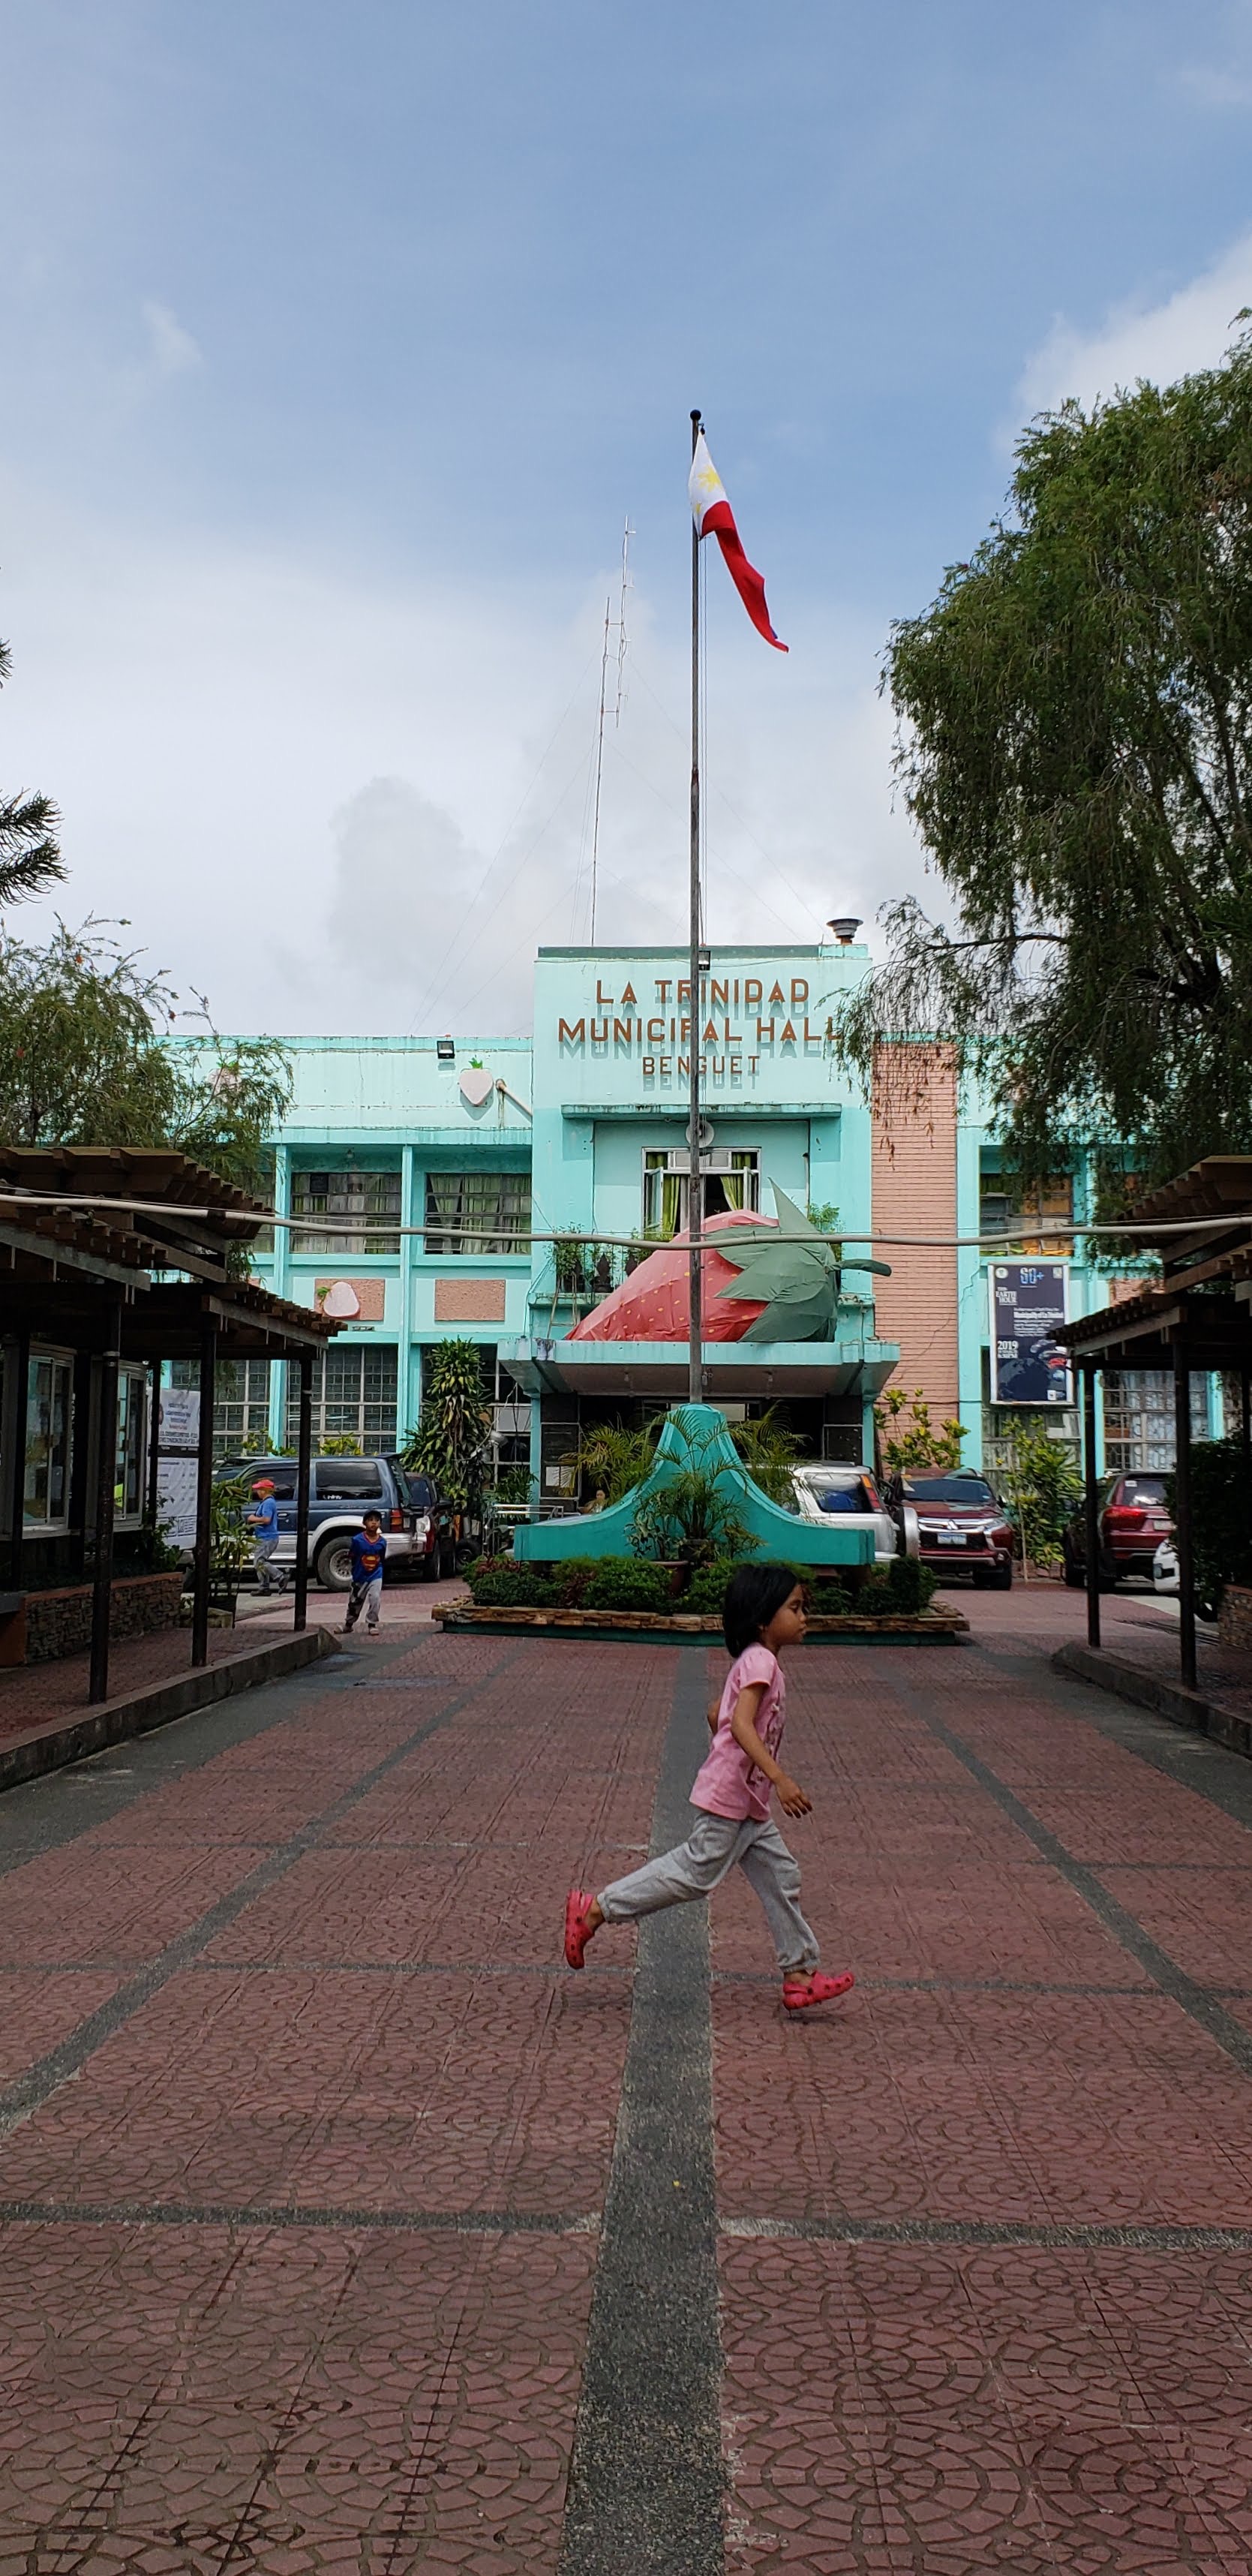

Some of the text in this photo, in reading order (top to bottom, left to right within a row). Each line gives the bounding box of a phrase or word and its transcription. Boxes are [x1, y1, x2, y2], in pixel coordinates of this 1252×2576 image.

[596, 978, 809, 1004] LA TRINIDAD
[558, 1016, 842, 1042] MUNICIPAL HALL
[642, 1055, 760, 1075] BENGUET
[997, 1340, 1019, 1350] 2019
